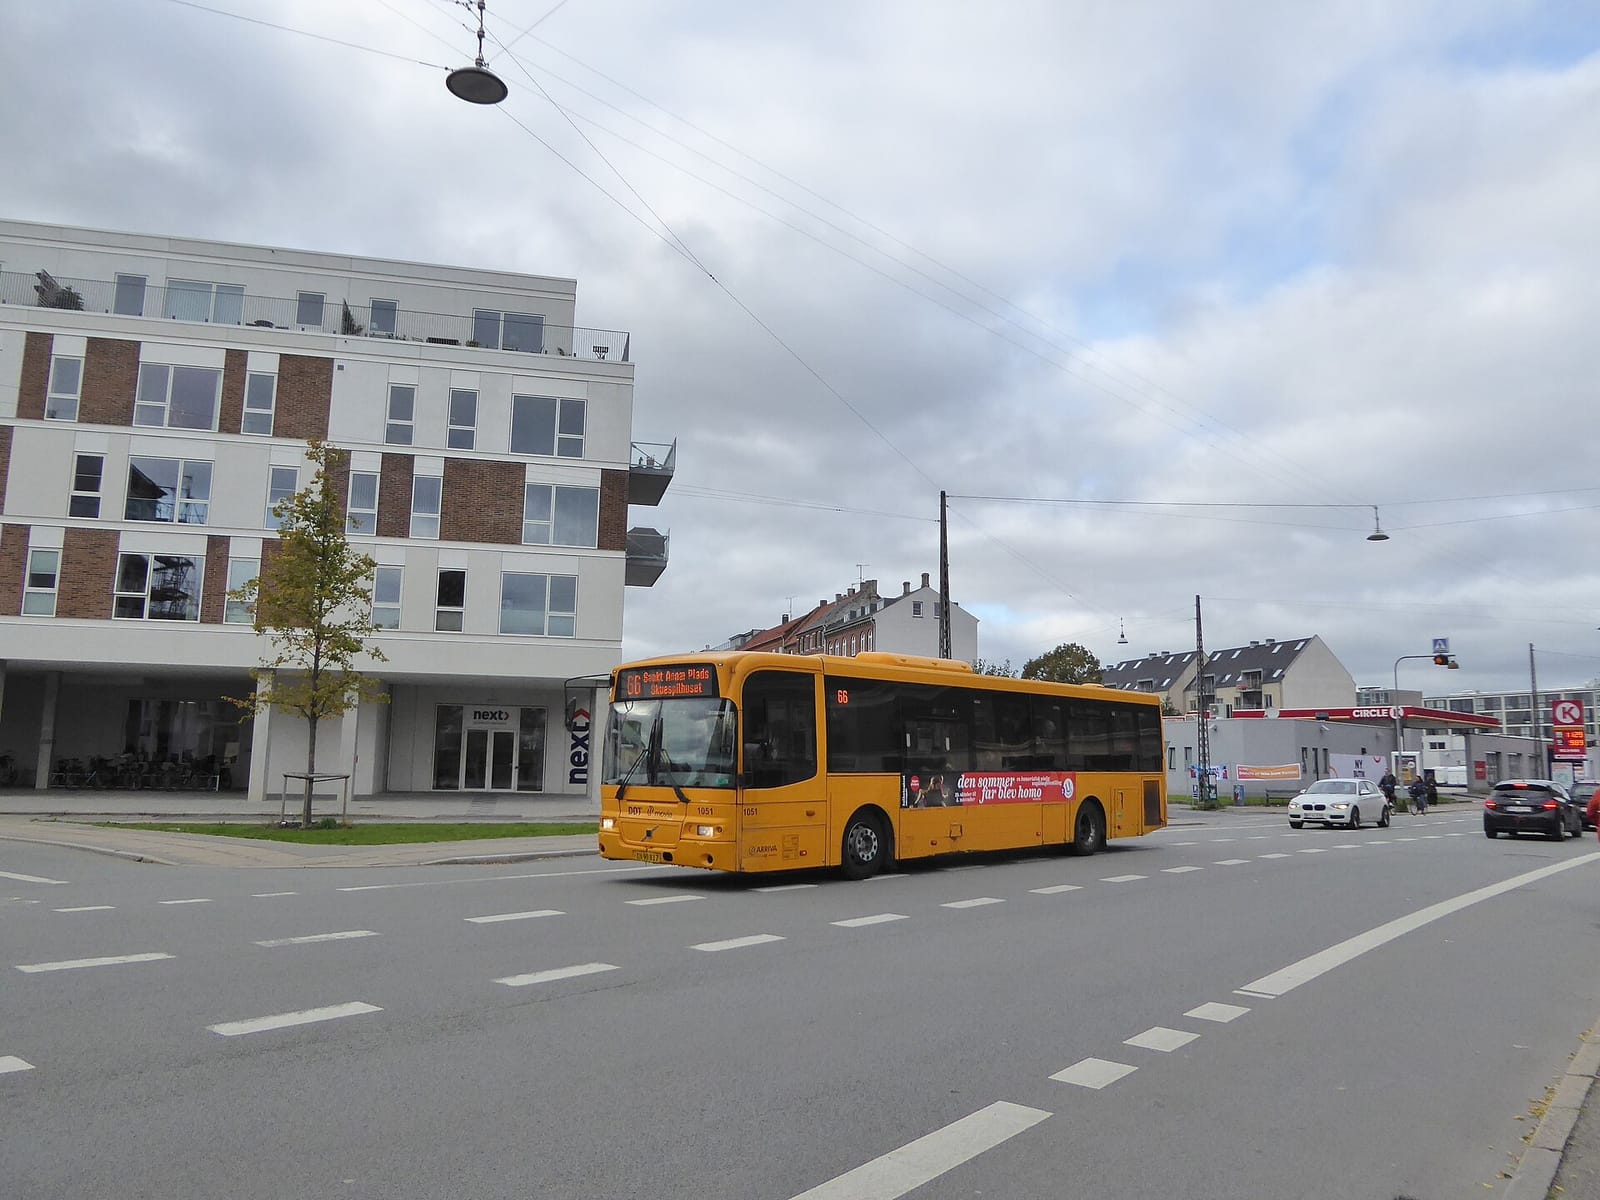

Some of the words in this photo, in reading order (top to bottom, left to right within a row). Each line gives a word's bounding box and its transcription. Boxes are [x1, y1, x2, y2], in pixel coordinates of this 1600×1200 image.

[688, 668, 710, 680] Plads
[627, 675, 641, 696] 66
[837, 689, 848, 704] 66
[473, 710, 504, 721] next
[1352, 708, 1388, 718] CIRCLE
[1560, 705, 1578, 722] K
[569, 721, 591, 784] next
[1354, 759, 1363, 769] NY
[957, 774, 976, 789] den
[978, 776, 1015, 788] sommer
[979, 785, 997, 803] far
[998, 785, 1017, 799] blev
[1017, 784, 1042, 798] homo
[697, 807, 713, 816] 1051
[743, 808, 758, 816] 1051
[756, 845, 778, 853] ARRIVA
